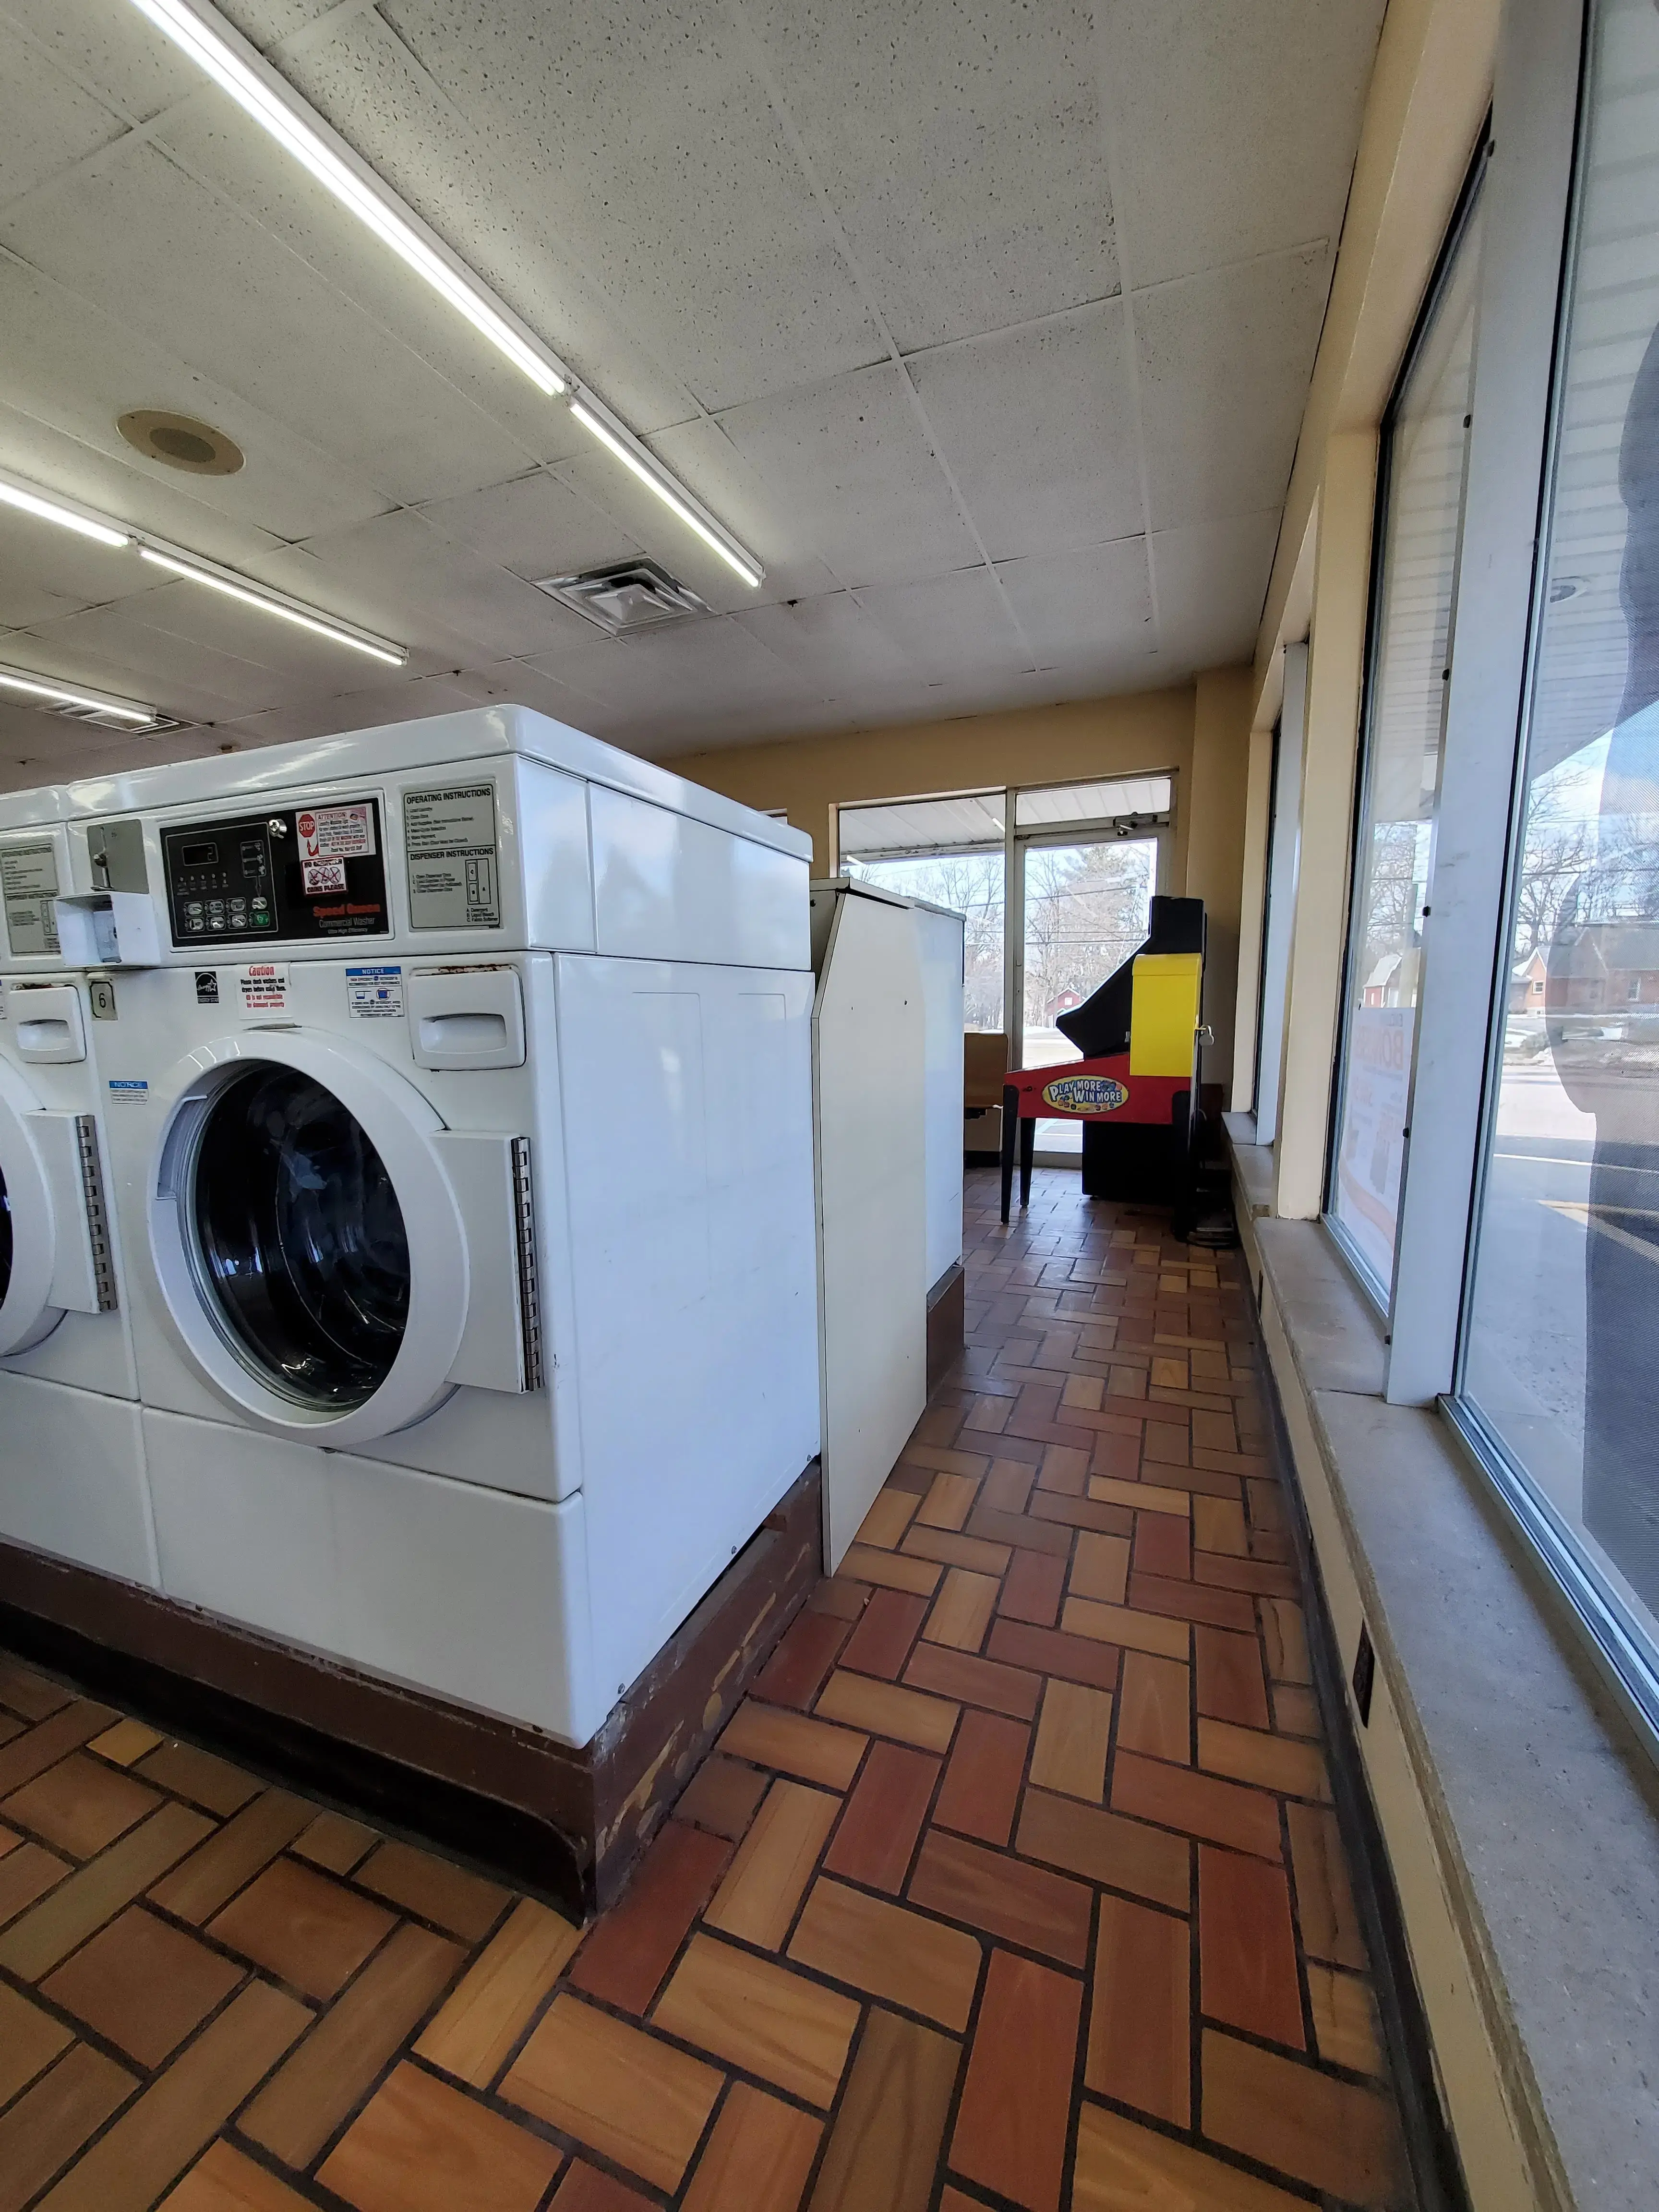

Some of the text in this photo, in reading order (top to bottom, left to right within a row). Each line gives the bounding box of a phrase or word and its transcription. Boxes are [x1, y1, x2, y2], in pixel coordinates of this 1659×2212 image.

[407, 788, 491, 804] OPERATING INSTRUCTIONS
[300, 821, 314, 831] STOP
[410, 848, 493, 860] DISPENSER INSTRUCTIONS
[353, 917, 375, 926] Washer
[249, 966, 274, 976] Caution
[98, 993, 106, 1008] 6
[1049, 1080, 1101, 1101] PLAY MORE
[1073, 1087, 1121, 1103] WIN MORE
